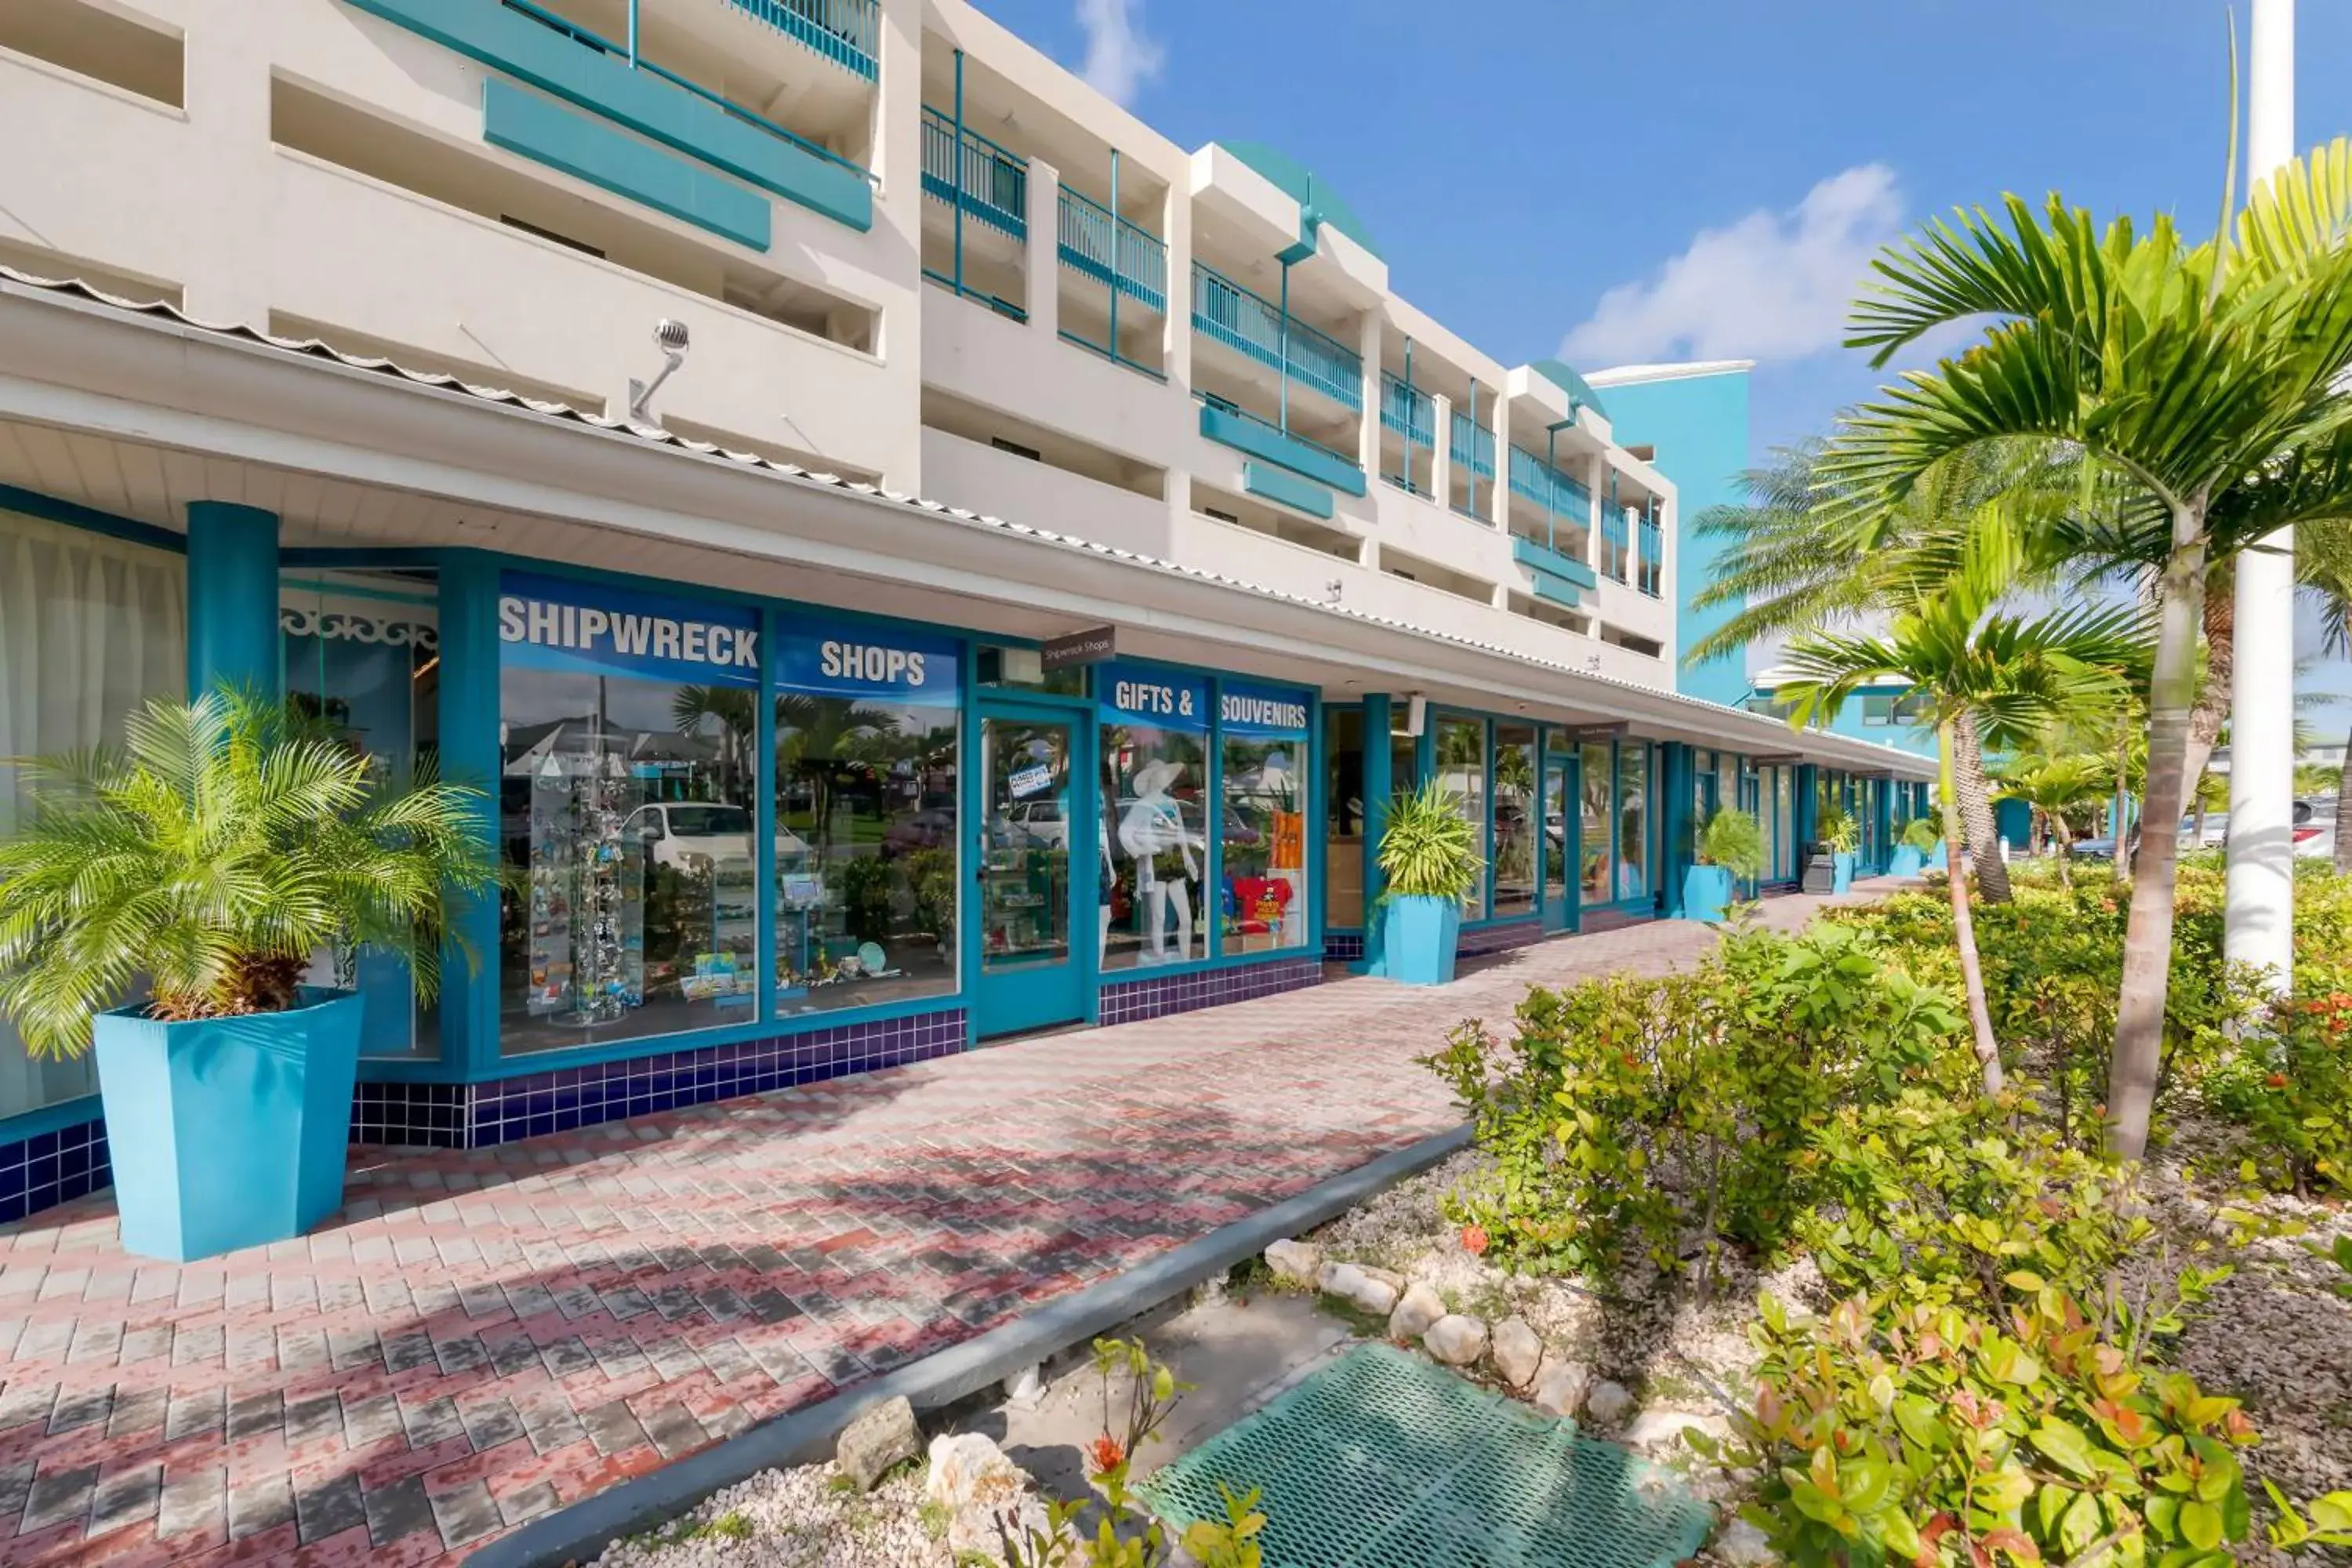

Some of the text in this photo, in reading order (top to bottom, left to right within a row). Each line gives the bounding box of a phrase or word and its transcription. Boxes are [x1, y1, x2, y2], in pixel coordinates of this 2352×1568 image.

[499, 596, 924, 686] SHIPWRECK SHOPS
[1084, 639, 1109, 652] Shops
[1116, 681, 1306, 728] GIFTS & SOUVENIRS
